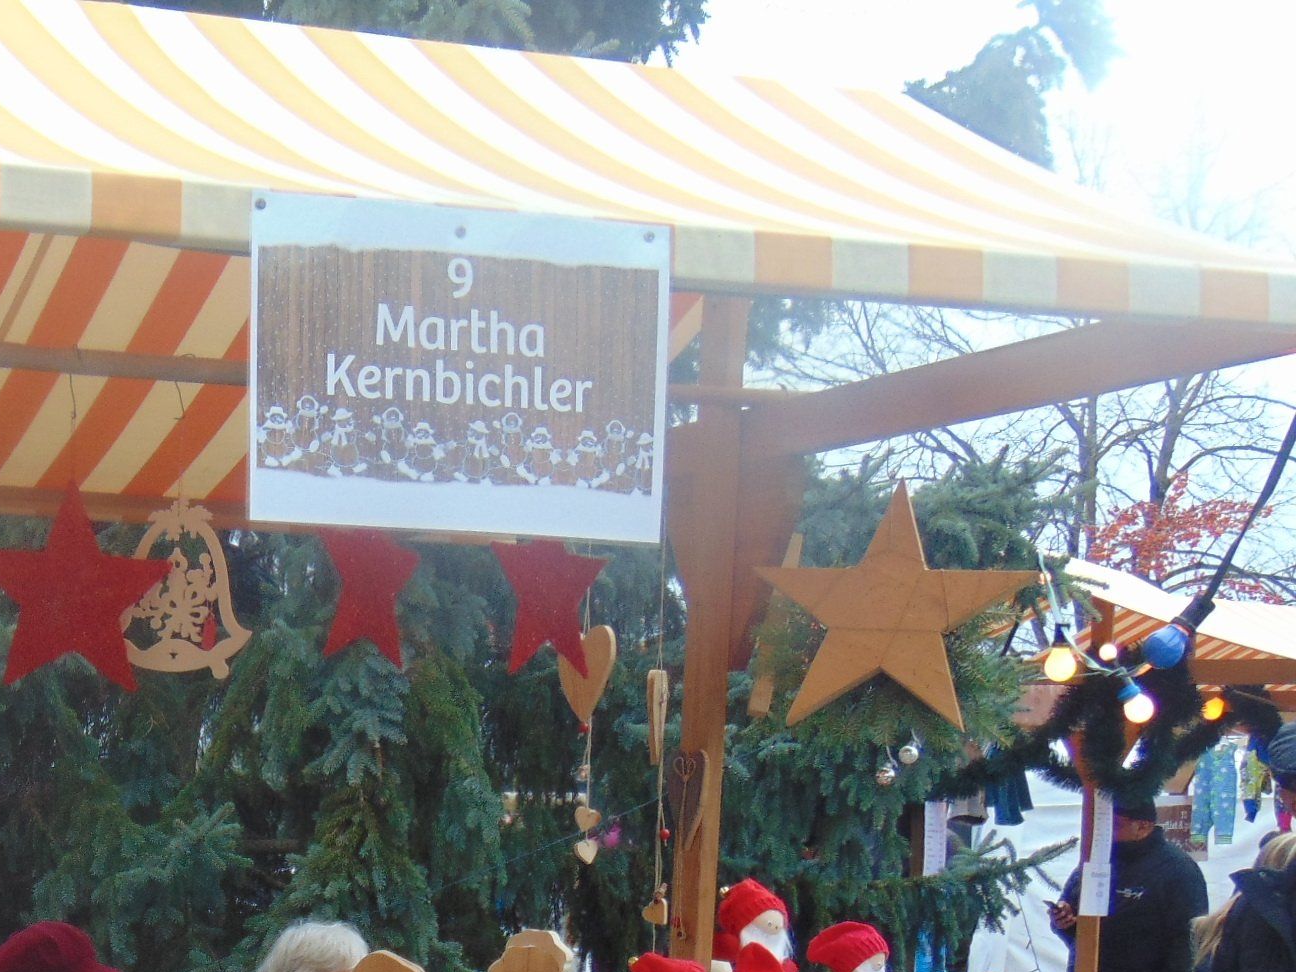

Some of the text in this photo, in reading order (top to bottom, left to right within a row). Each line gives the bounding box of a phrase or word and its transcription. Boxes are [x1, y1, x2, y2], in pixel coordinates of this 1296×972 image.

[447, 258, 474, 299] 9
[376, 303, 545, 358] Martha
[326, 353, 593, 413] Kernbichler
